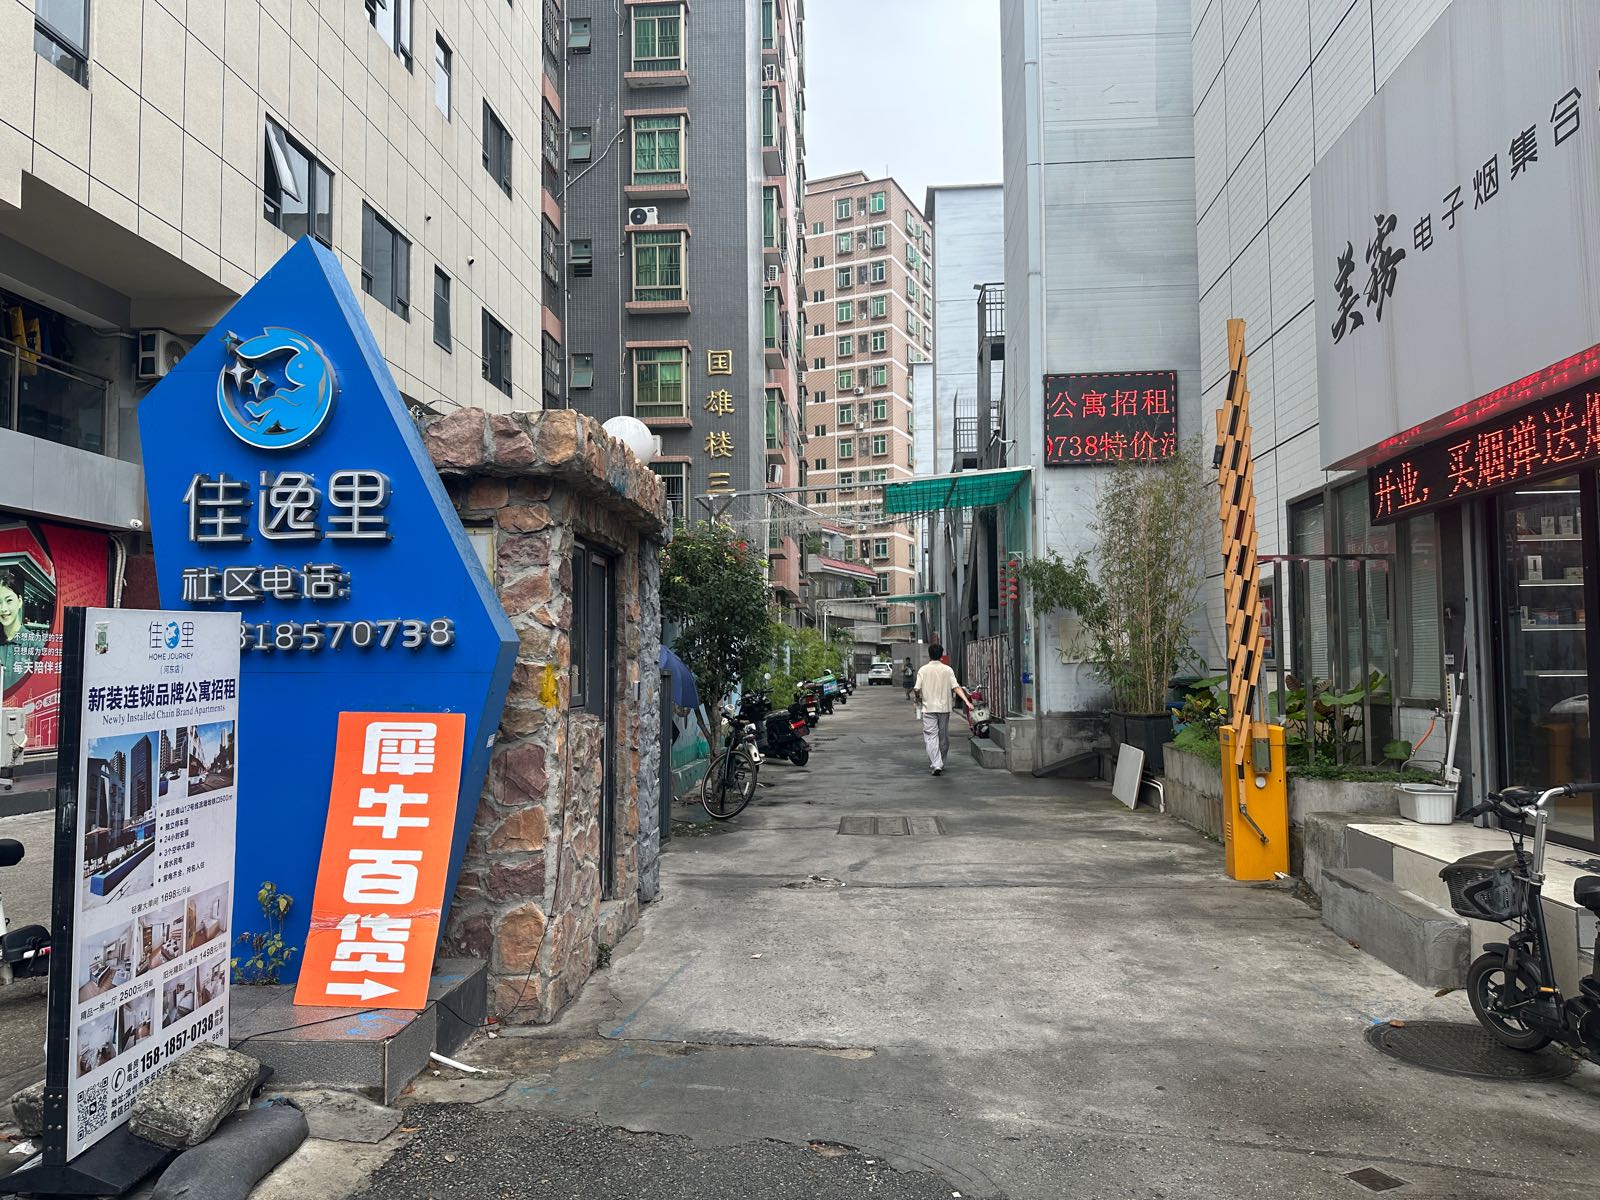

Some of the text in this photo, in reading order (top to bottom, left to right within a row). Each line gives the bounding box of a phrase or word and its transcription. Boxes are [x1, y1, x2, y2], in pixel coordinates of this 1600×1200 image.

[1050, 389, 1170, 419] 公寓招租
[183, 469, 393, 543] 佳逸里
[239, 618, 454, 650] 18570738
[148, 652, 194, 661] HOME JOURNEY
[87, 678, 236, 713] 新装连锁品牌公寓招租
[102, 704, 226, 726] Newly Installed Chain Brand Apartments
[329, 721, 437, 973] 犀牛百货
[140, 1013, 213, 1073] 158-1857-0738
